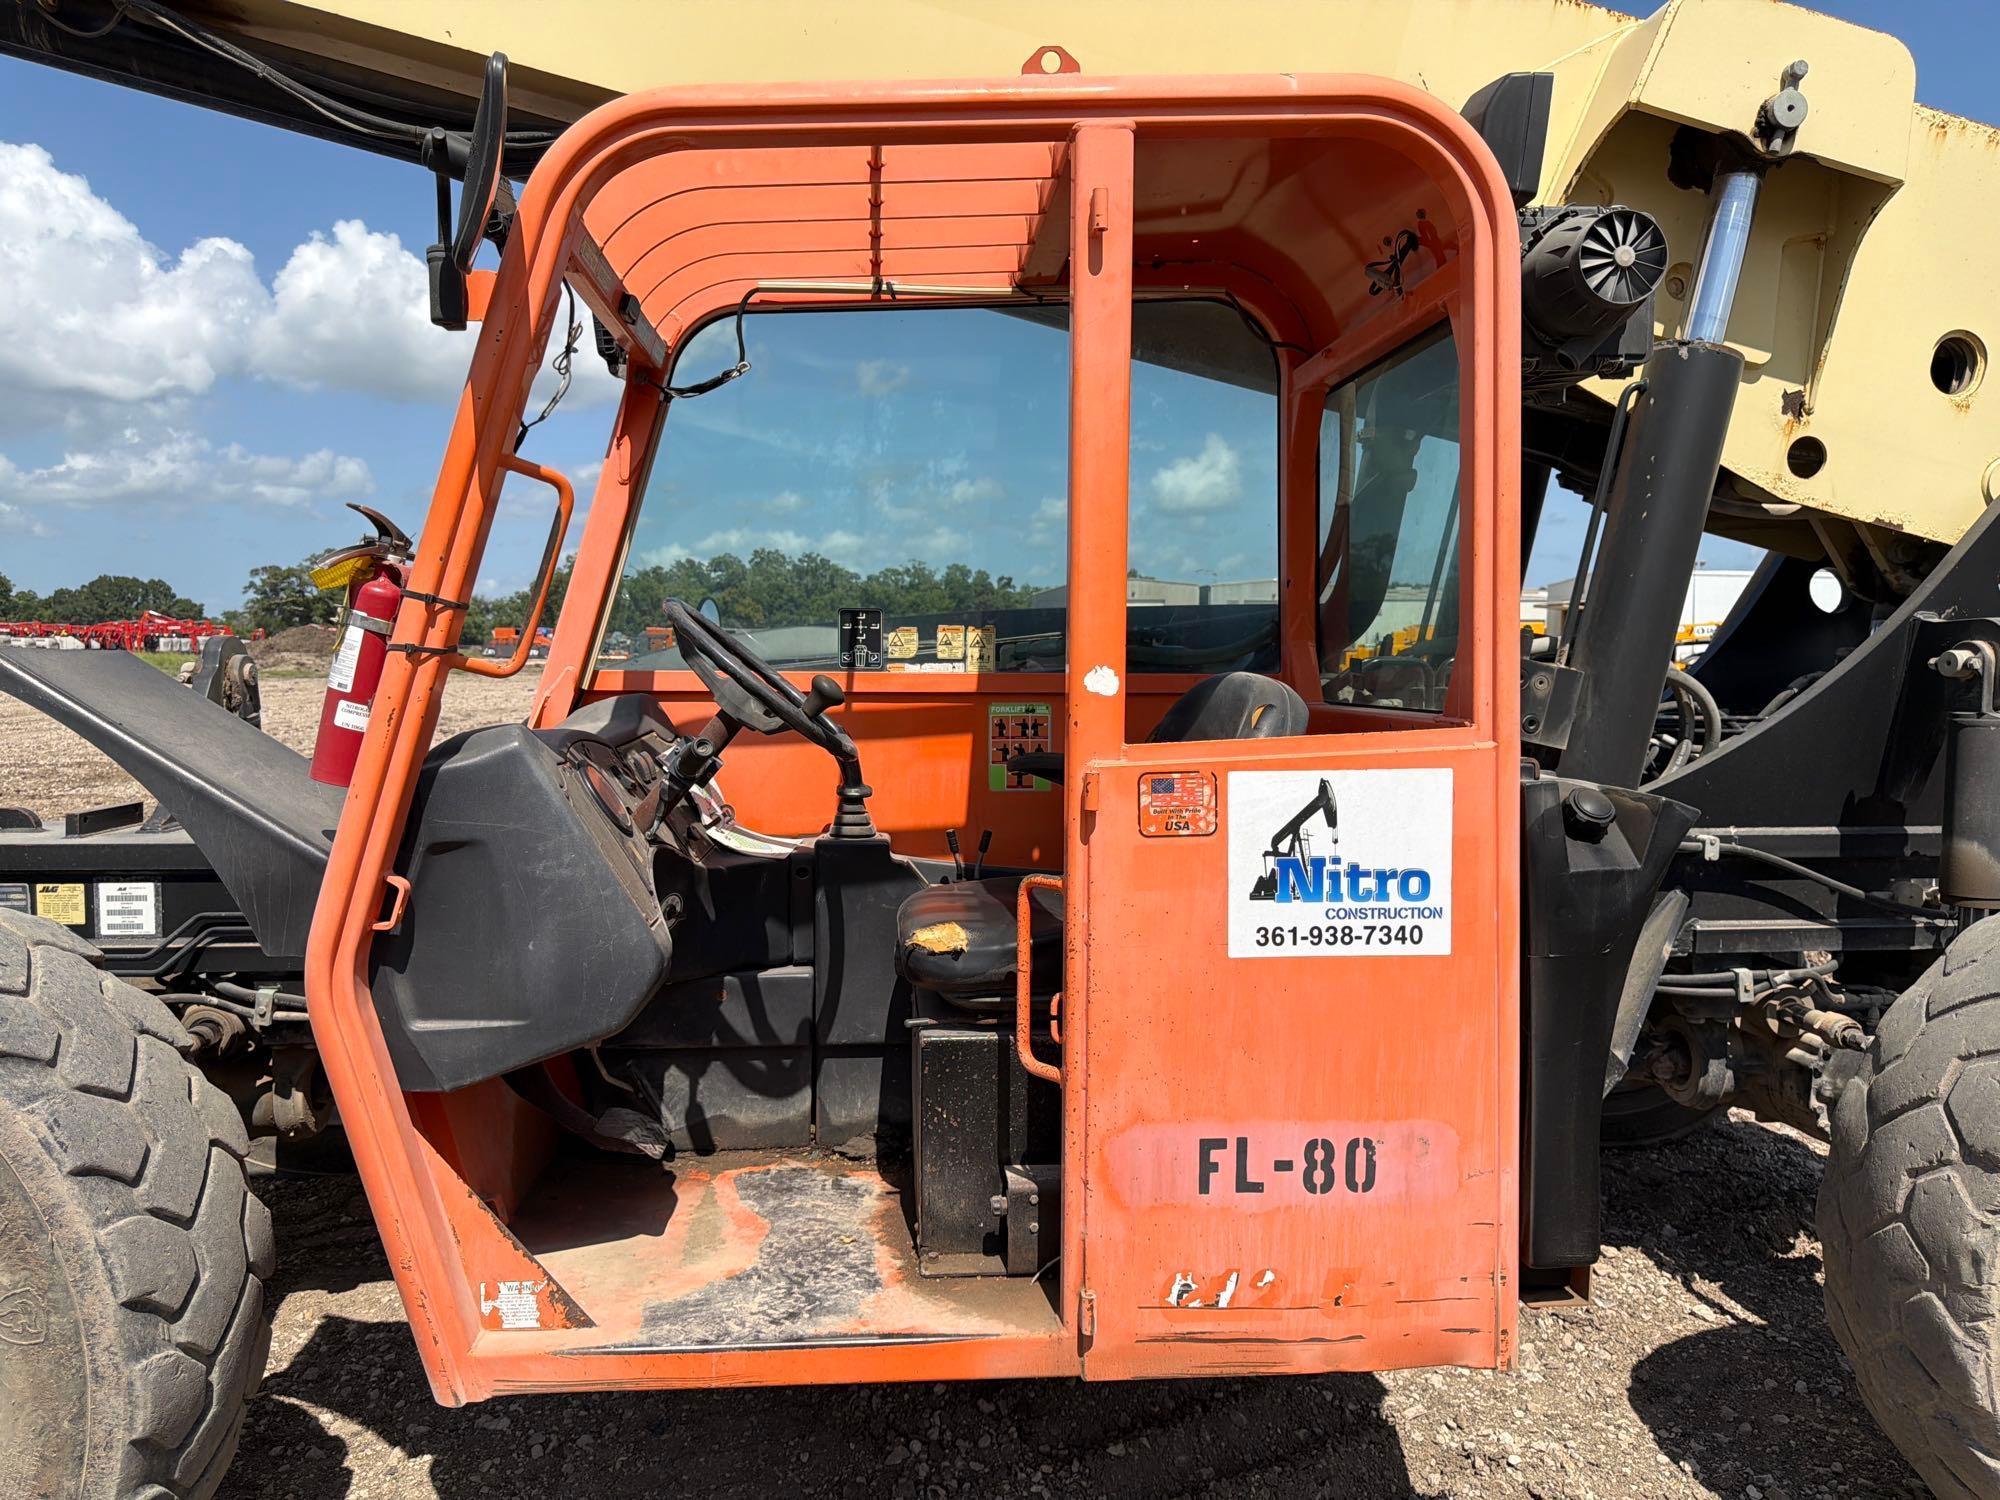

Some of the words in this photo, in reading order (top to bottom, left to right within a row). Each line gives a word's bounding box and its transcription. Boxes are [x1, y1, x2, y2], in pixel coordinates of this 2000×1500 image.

[1165, 821, 1190, 831] USA
[1274, 855, 1432, 903] Nitro
[1325, 907, 1443, 920] CONSTRUCTION
[1255, 925, 1423, 947] 361-938-7340
[1198, 1136, 1377, 1195] FL-80
